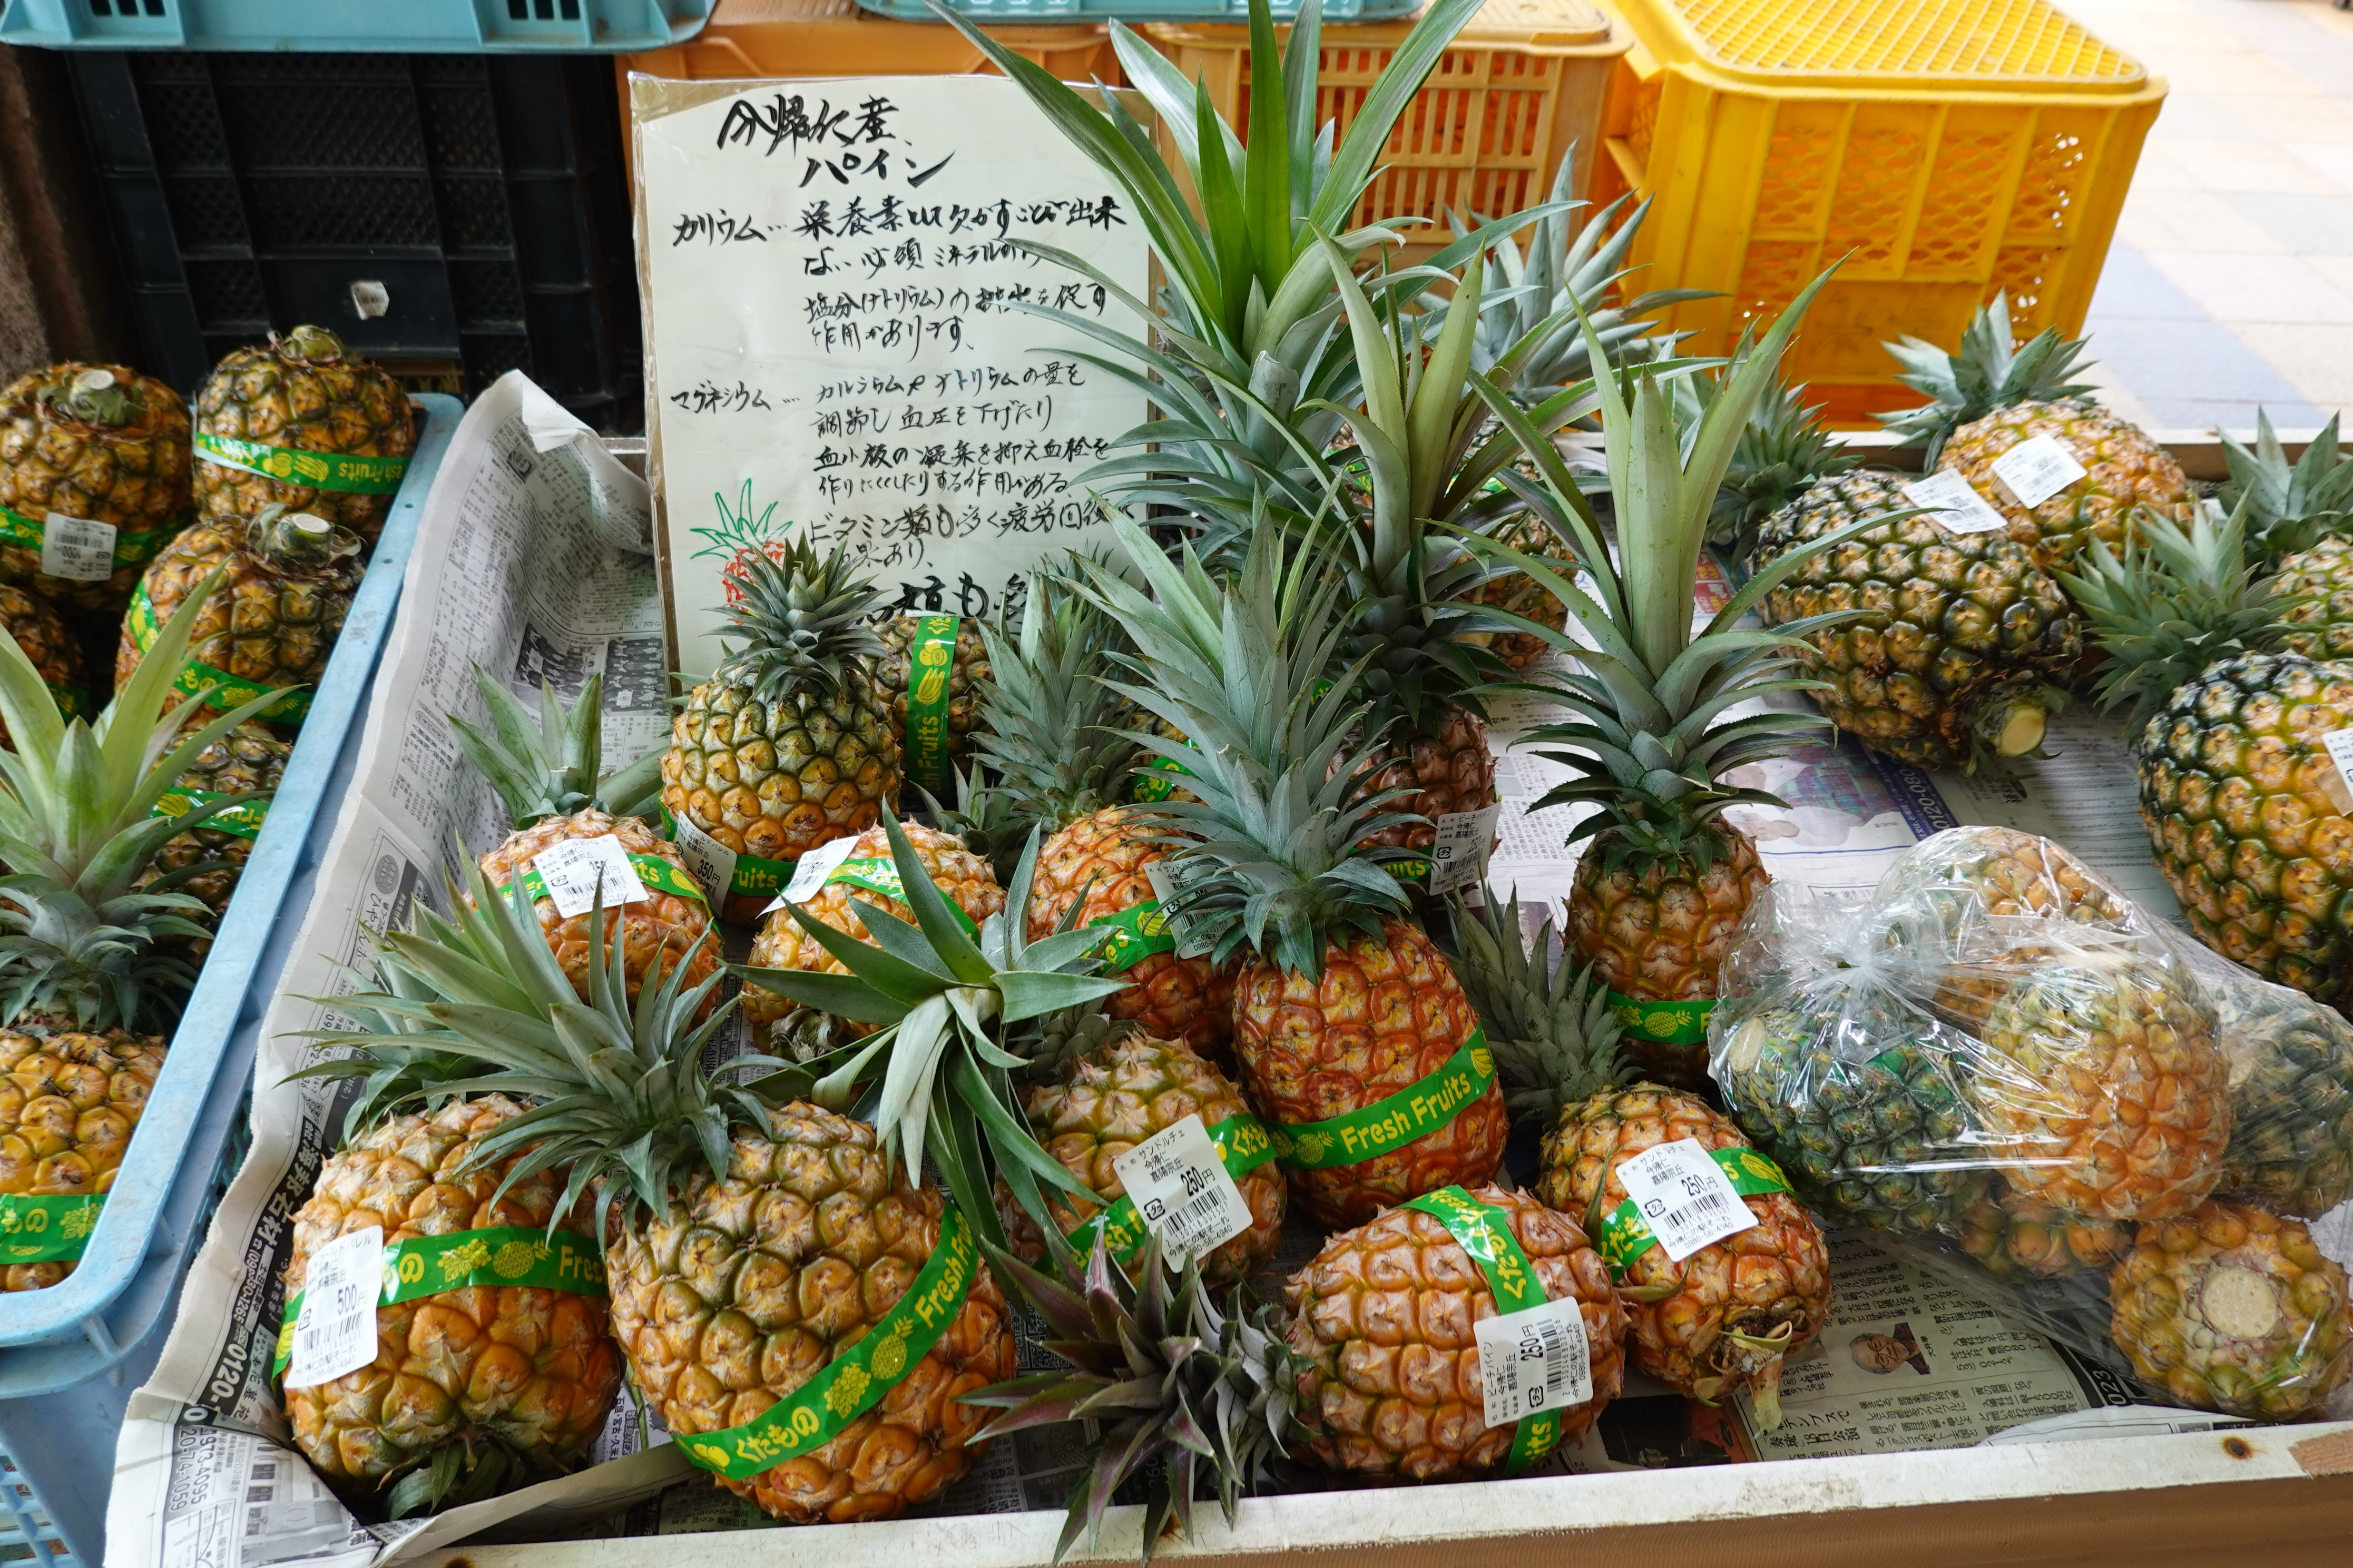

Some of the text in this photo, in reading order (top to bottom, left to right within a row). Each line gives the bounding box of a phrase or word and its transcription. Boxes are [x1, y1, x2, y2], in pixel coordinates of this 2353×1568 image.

[1340, 1071, 1471, 1155] Fresh Fruits
[1180, 1166, 1216, 1197] 250円
[1681, 1173, 1719, 1197] 250円
[559, 1245, 606, 1284] Fres
[914, 1257, 966, 1329] Fresh
[1519, 1324, 1544, 1363] 250円
[737, 1406, 820, 1464] くだもの
